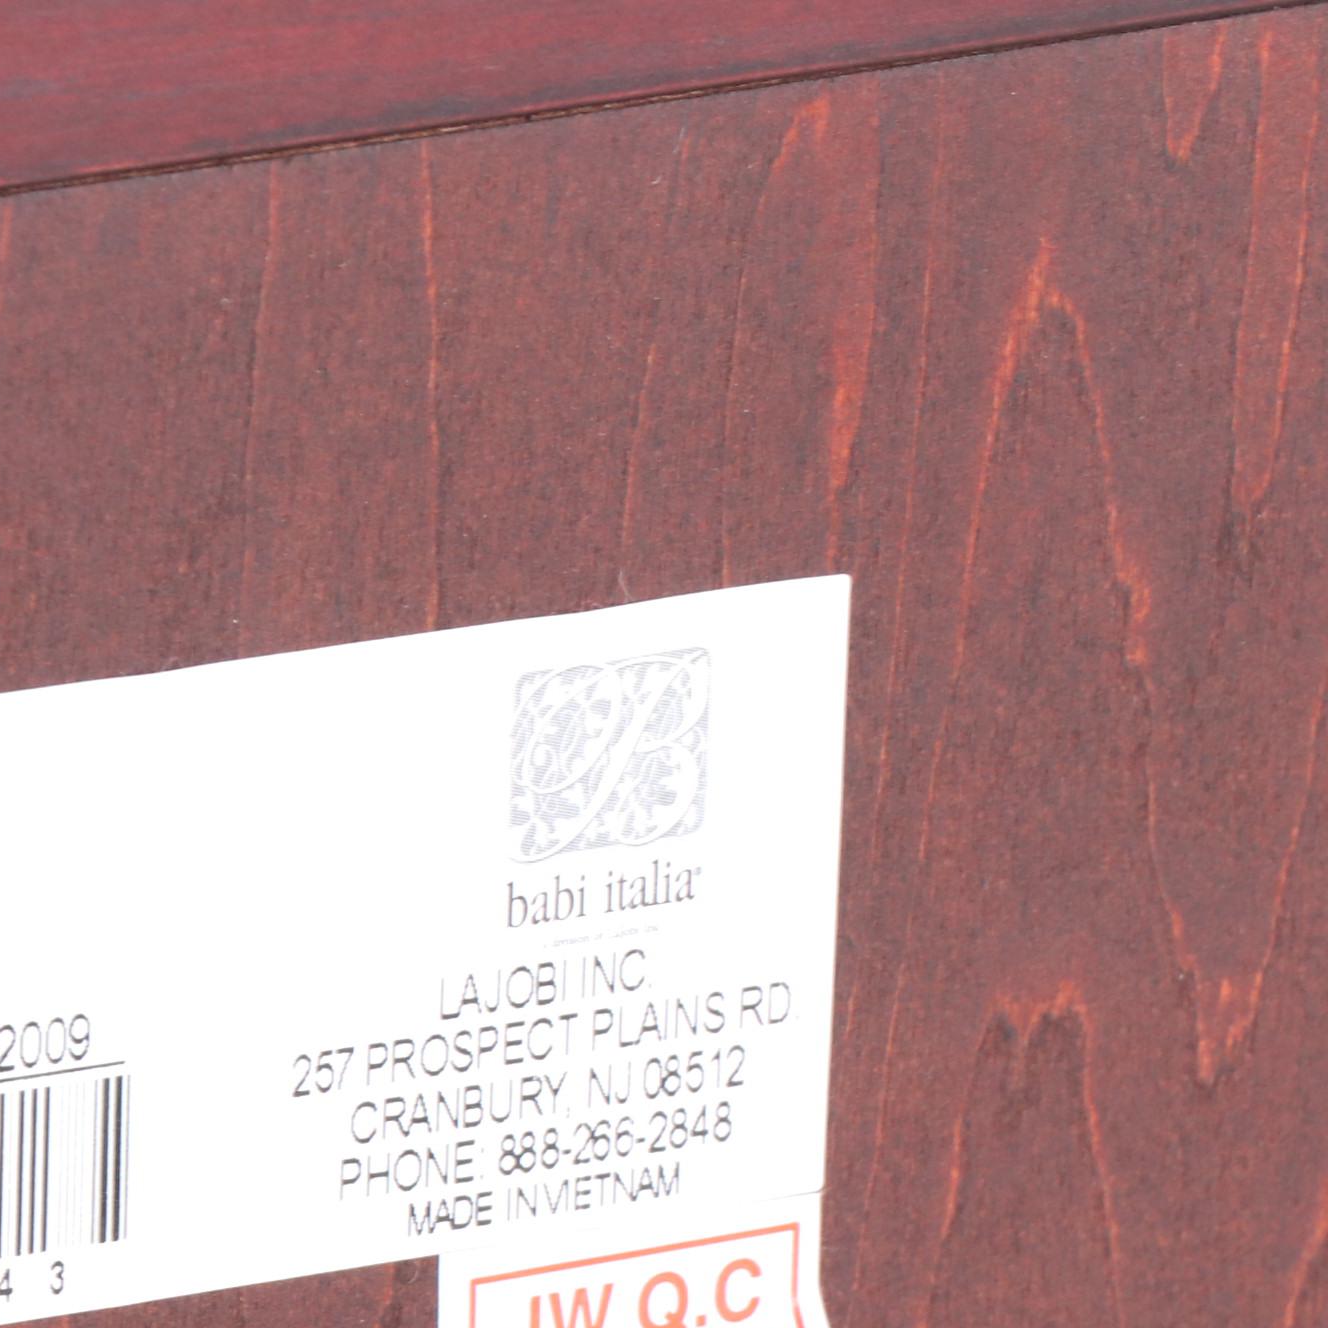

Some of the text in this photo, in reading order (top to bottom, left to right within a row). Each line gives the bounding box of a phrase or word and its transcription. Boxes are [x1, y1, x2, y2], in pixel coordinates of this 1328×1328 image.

[506, 875, 586, 928] babi
[440, 958, 566, 1020] LAJOBI
[292, 1047, 355, 1098] 257
[366, 1013, 578, 1086] PROSPECT
[592, 991, 726, 1051] PLAINS
[588, 1062, 632, 1108] NJ
[644, 1045, 747, 1099] 08512
[339, 1101, 733, 1200] PHONE: 888-266-2848
[407, 1161, 681, 1237] MADE IN VIETNAM
